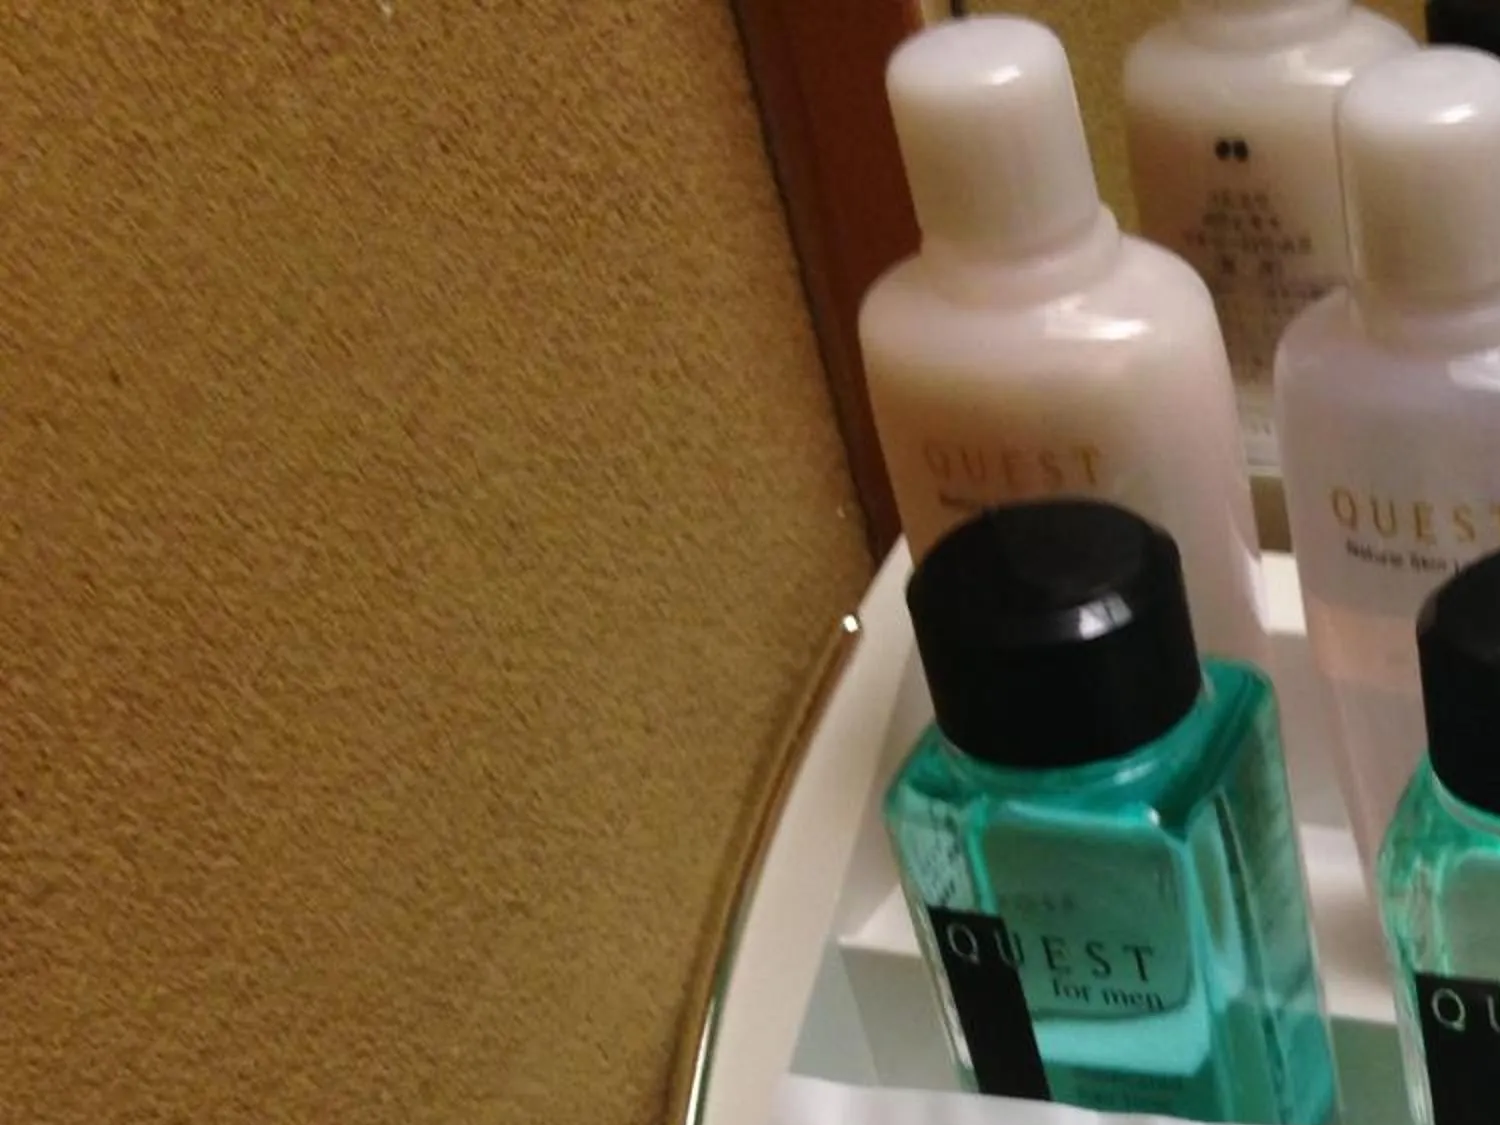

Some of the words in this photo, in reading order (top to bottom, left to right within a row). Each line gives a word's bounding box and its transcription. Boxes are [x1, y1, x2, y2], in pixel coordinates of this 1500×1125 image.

[923, 438, 1098, 492] QUEST
[947, 923, 1154, 982] QUEST
[1052, 978, 1091, 1001] for
[1102, 987, 1164, 1011] men
